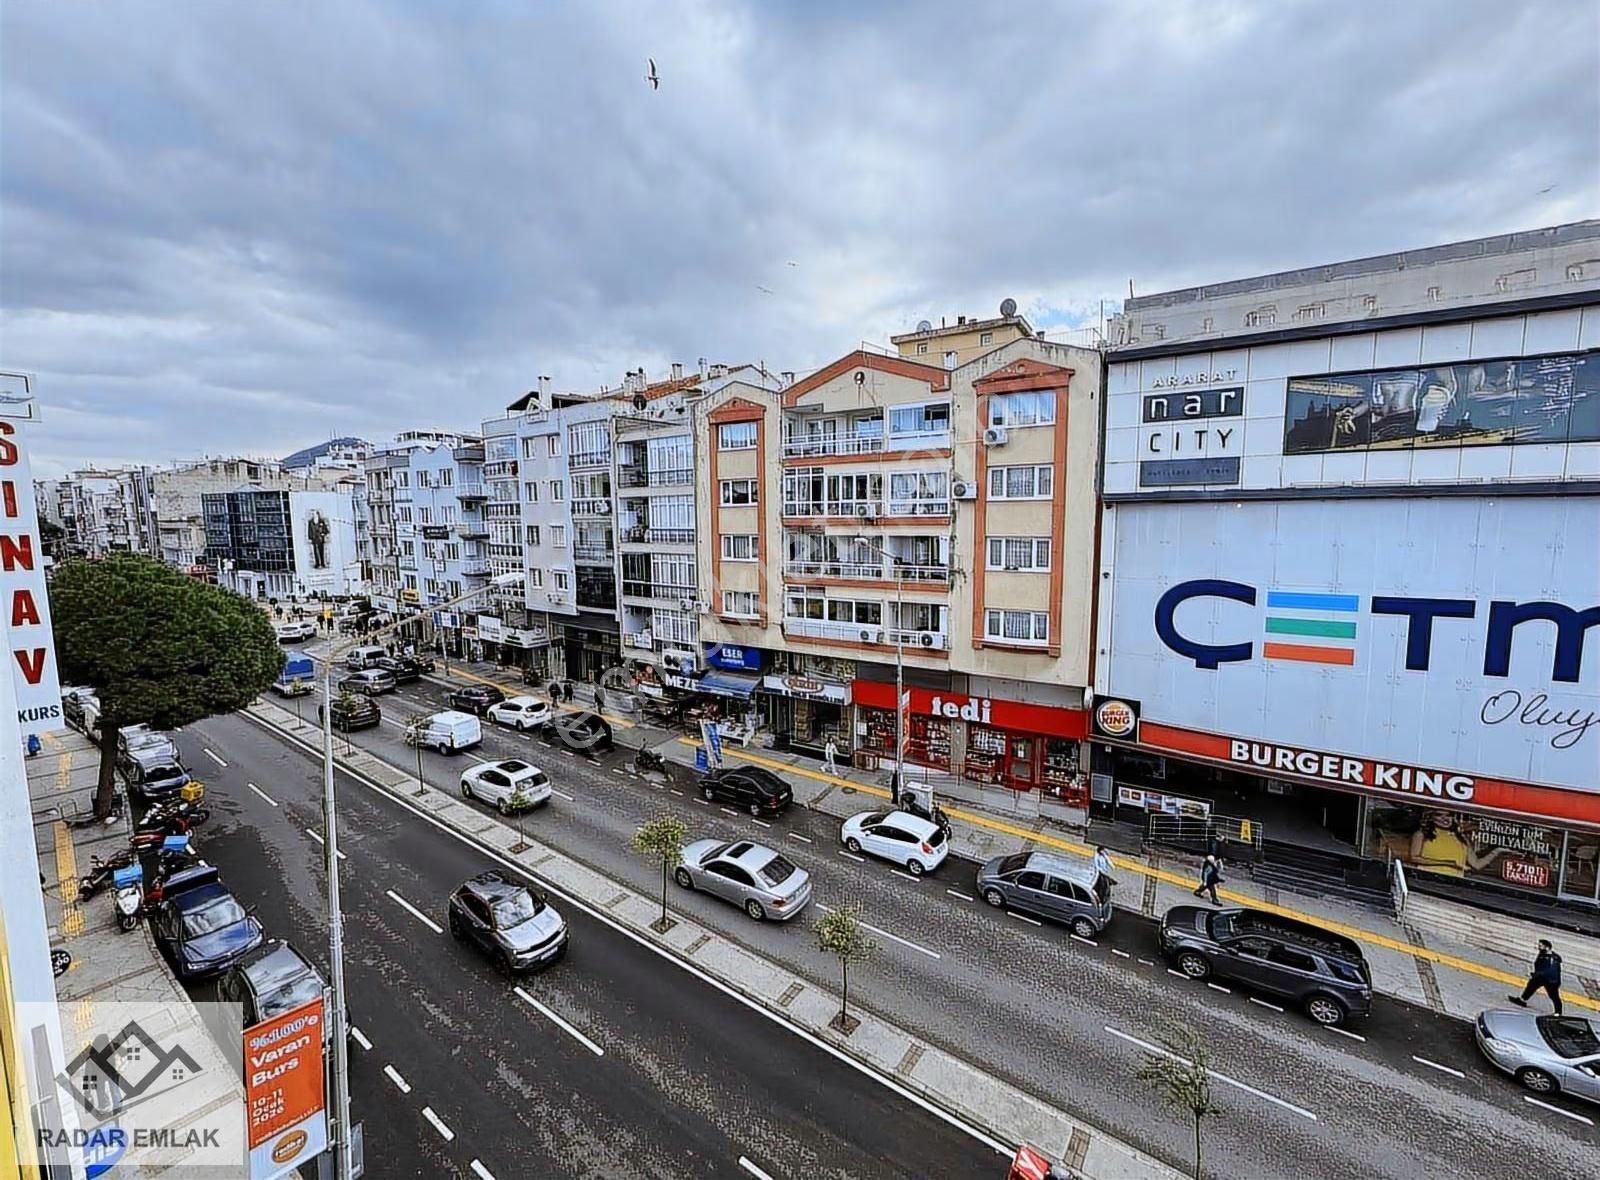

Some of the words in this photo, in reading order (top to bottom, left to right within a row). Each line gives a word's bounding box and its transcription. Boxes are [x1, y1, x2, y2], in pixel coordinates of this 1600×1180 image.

[1153, 368, 1236, 388] ARARAT
[1151, 391, 1235, 418] nar
[1149, 428, 1233, 452] CITY
[17, 704, 60, 724] KURS
[1102, 715, 1130, 725] KING
[1231, 740, 1364, 782] BURGER
[1375, 764, 1474, 800] KING
[251, 1035, 310, 1068] Varan
[252, 1057, 299, 1087] Burs
[252, 1088, 283, 1109] 10-11
[252, 1098, 285, 1117] Ocak
